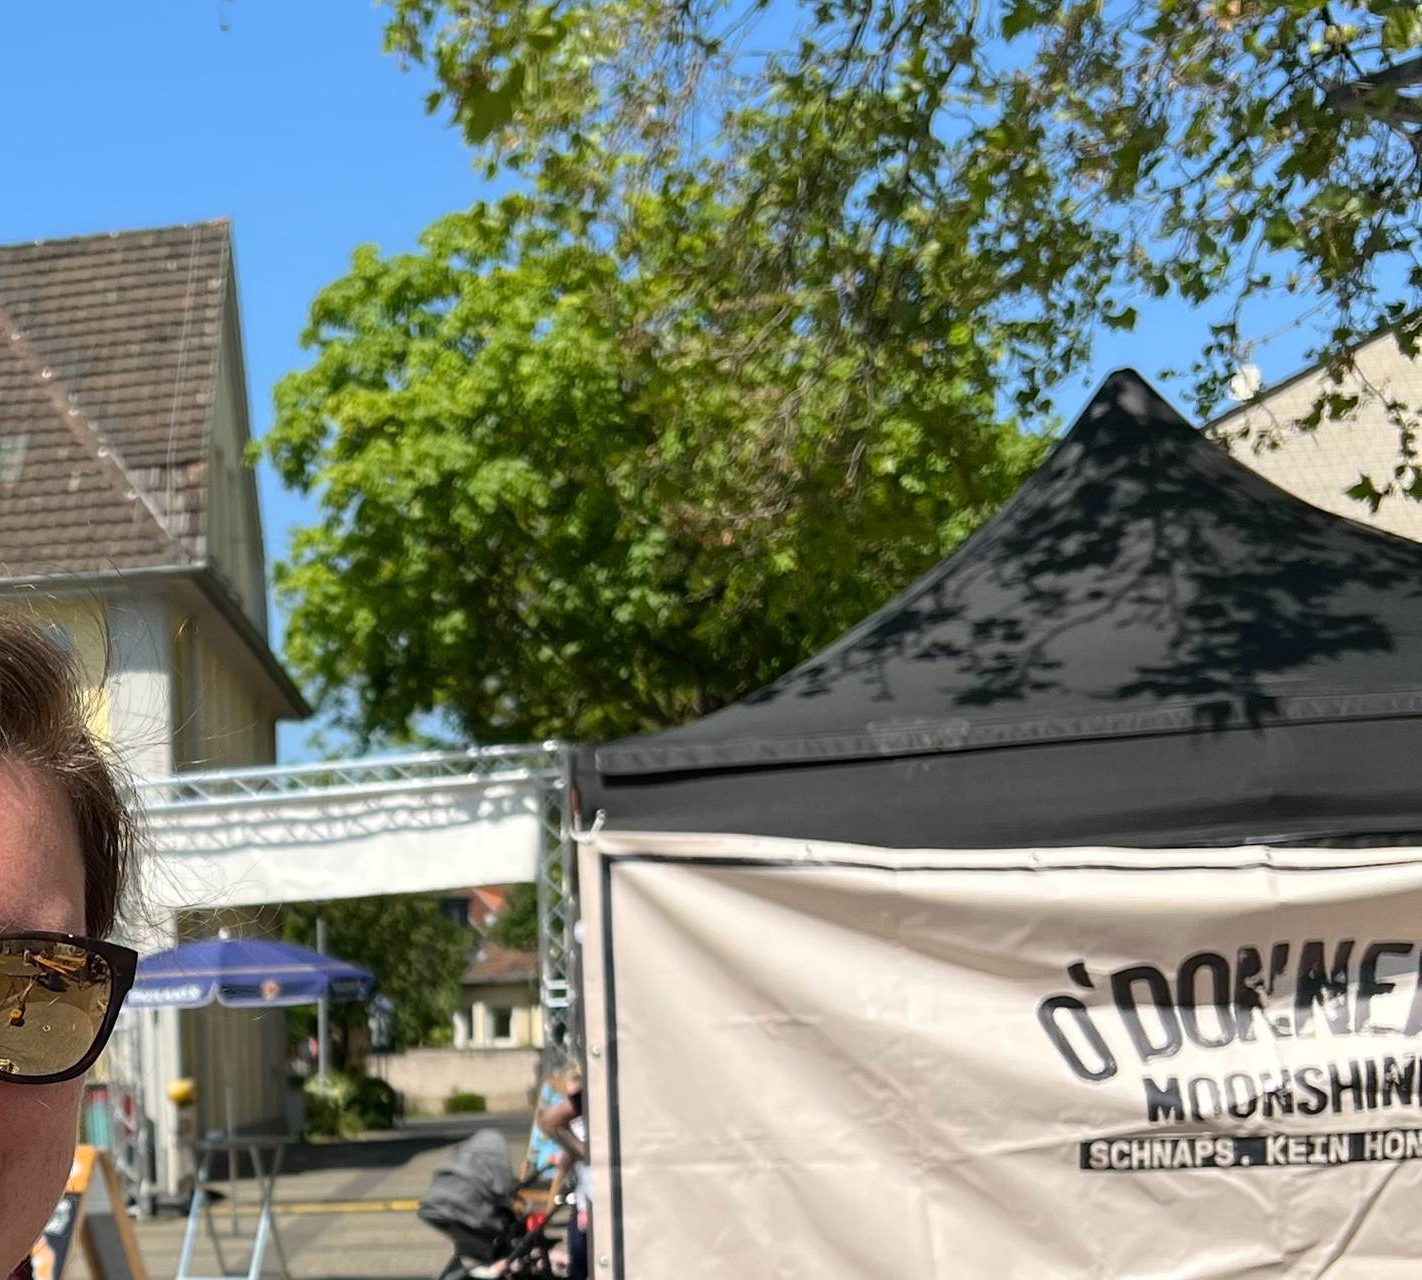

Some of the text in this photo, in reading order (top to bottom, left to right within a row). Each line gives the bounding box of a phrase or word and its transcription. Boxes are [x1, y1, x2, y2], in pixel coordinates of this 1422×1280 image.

[1142, 1055, 1422, 1122] MOONSHIN
[1089, 1138, 1251, 1169] SCHNAPS.
[1265, 1133, 1350, 1165] KEIN
